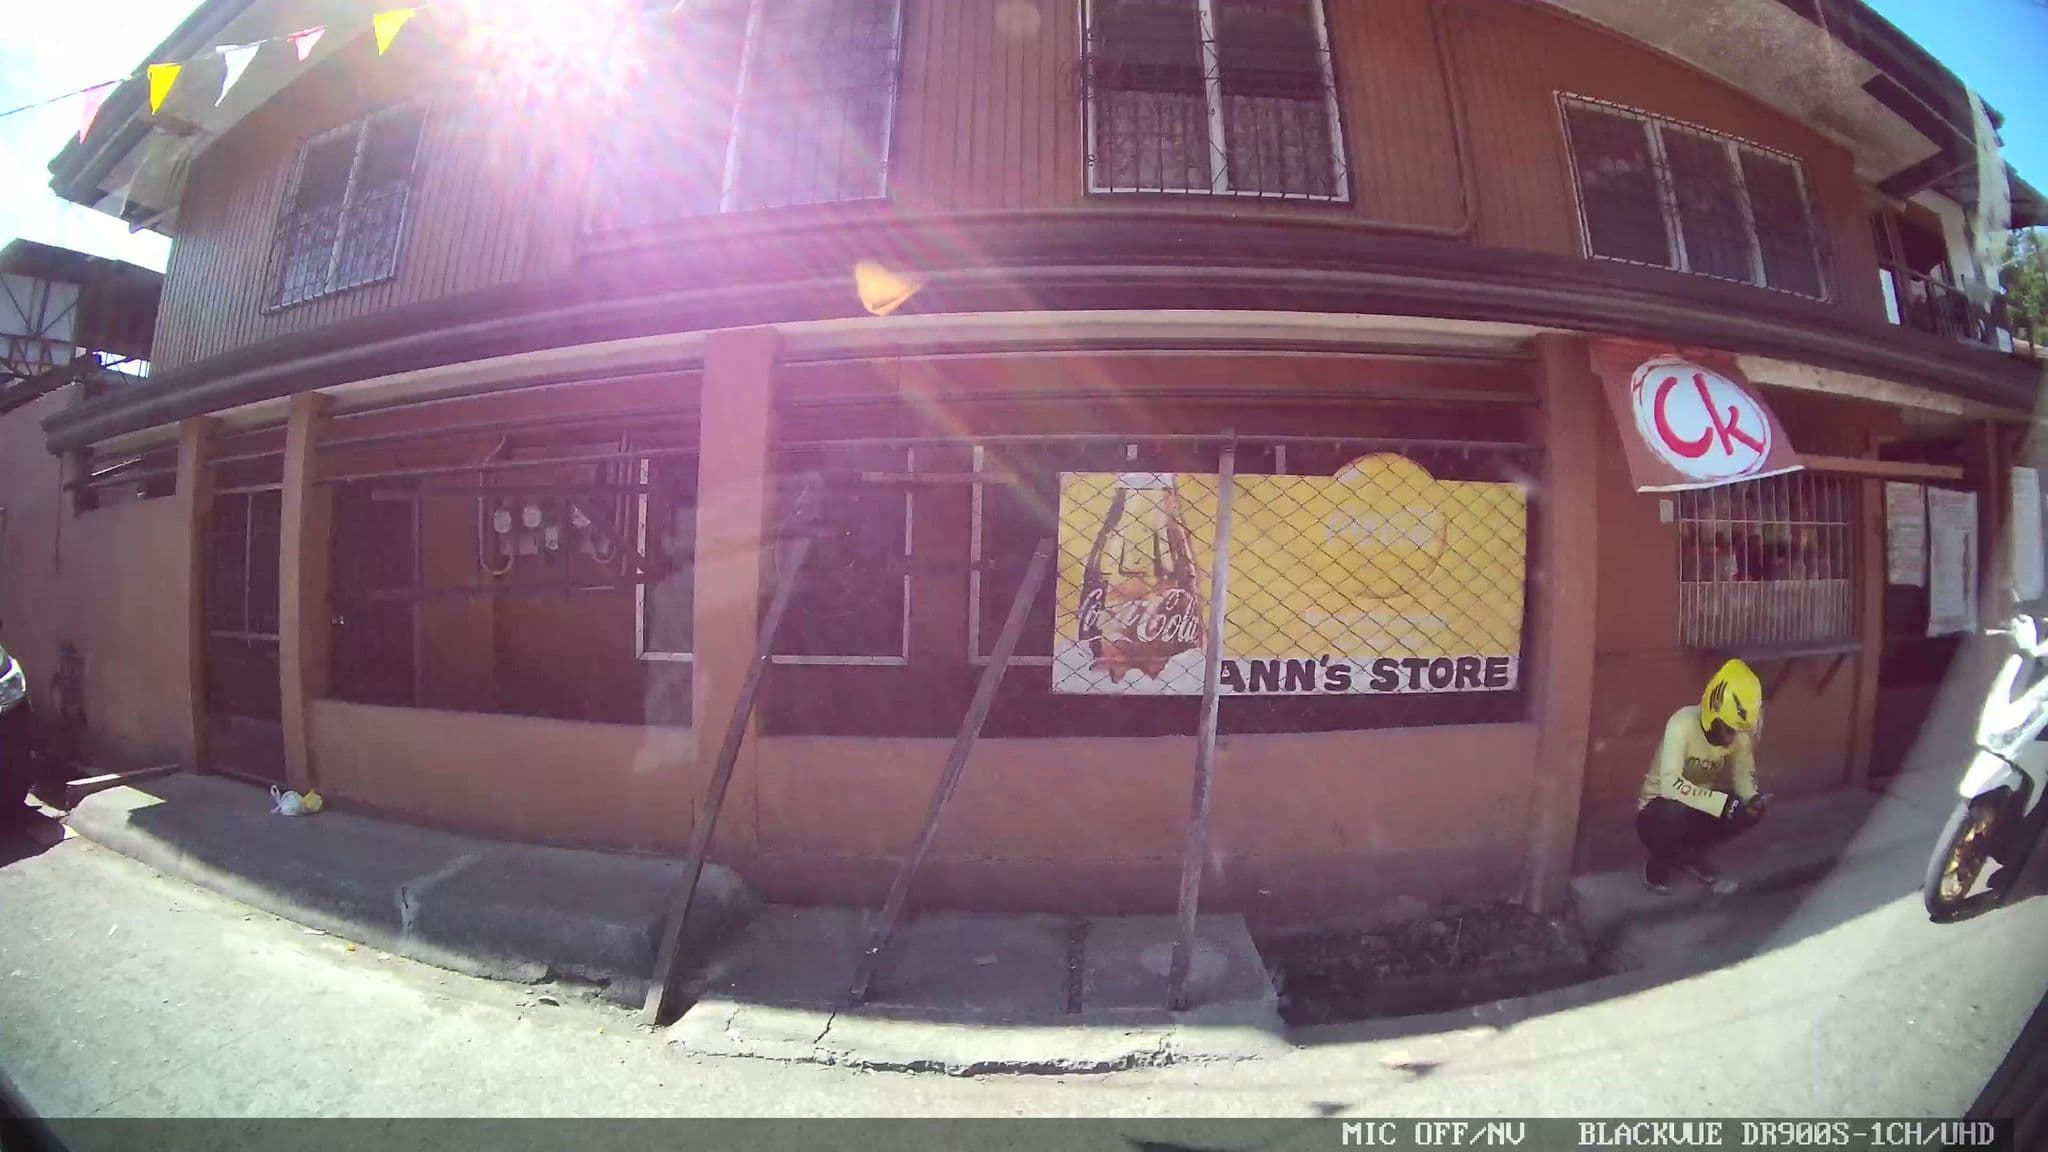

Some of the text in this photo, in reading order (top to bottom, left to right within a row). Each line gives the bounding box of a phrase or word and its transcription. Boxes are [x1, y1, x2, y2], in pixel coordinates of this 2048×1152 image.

[1653, 372, 1765, 458] Ck
[1220, 654, 1510, 692] ANN's STORE
